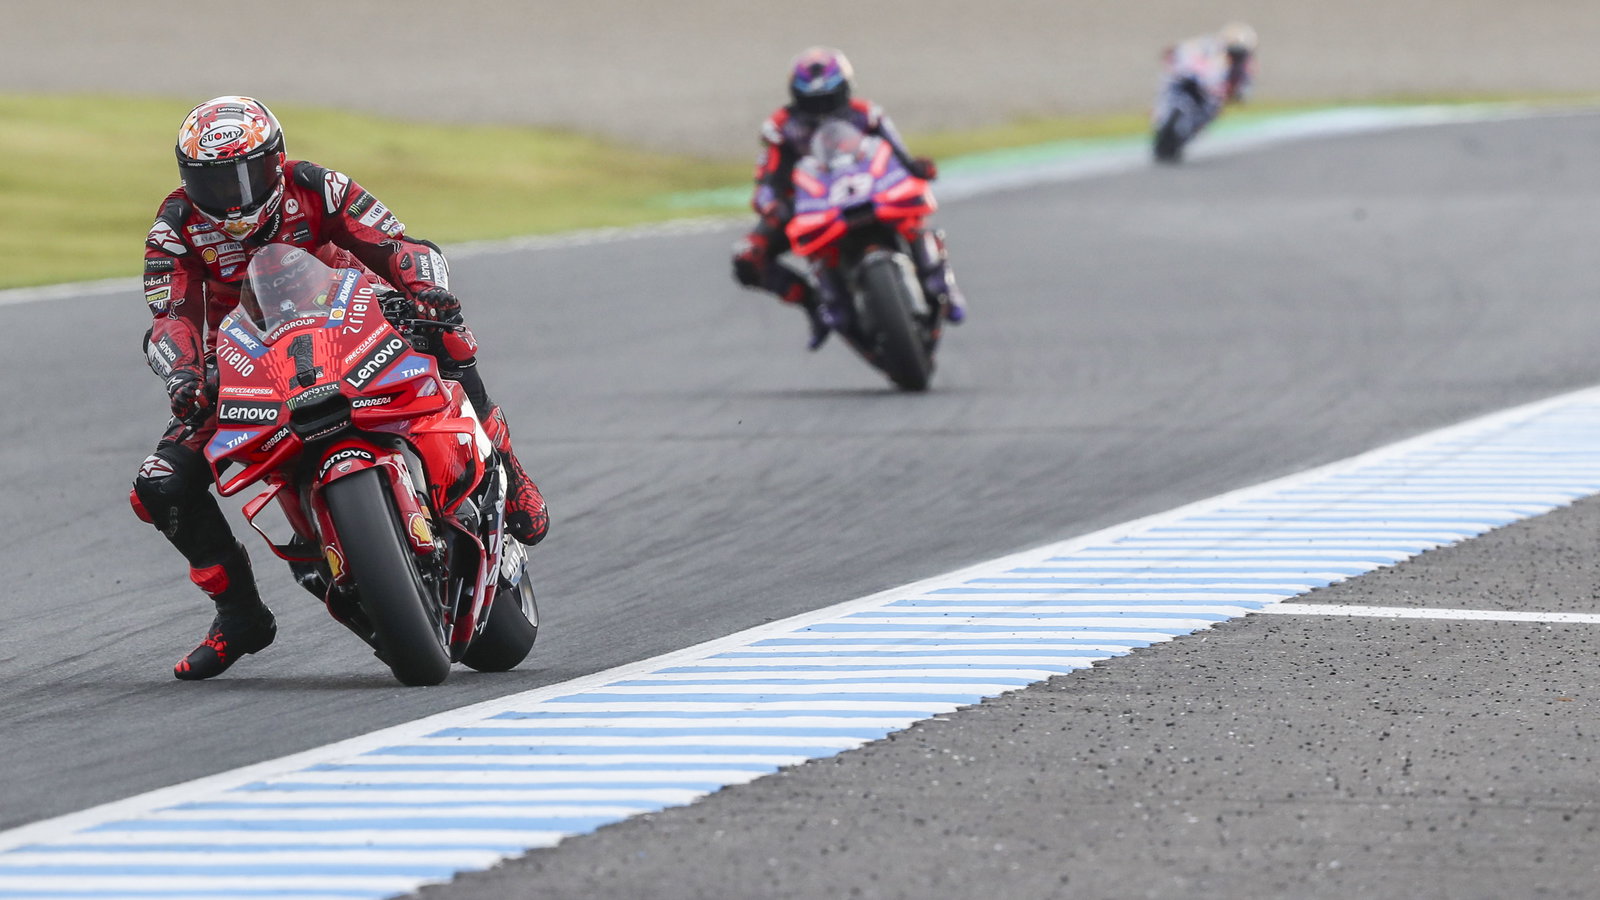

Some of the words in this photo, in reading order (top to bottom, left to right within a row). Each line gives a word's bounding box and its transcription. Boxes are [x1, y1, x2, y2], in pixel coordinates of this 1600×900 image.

[202, 130, 240, 144] SUOMY
[264, 213, 280, 241] Lenovo
[419, 254, 431, 280] Lenovo
[339, 271, 357, 304] ADVANCE
[159, 336, 177, 361] Lenovo
[228, 327, 260, 351] ADVANCE
[345, 323, 389, 364] FRECCIAROSSA
[286, 334, 325, 391] 1
[346, 338, 403, 388] Lenovo
[401, 367, 426, 378] TIM
[221, 387, 274, 395] FRECCIAROSSA
[295, 383, 339, 402] MONSTER
[352, 396, 391, 408] CARRERA
[219, 404, 278, 421] Lenovo
[226, 432, 248, 449] TIM
[261, 427, 290, 452] CARRERA
[320, 449, 372, 479] Lenovo
